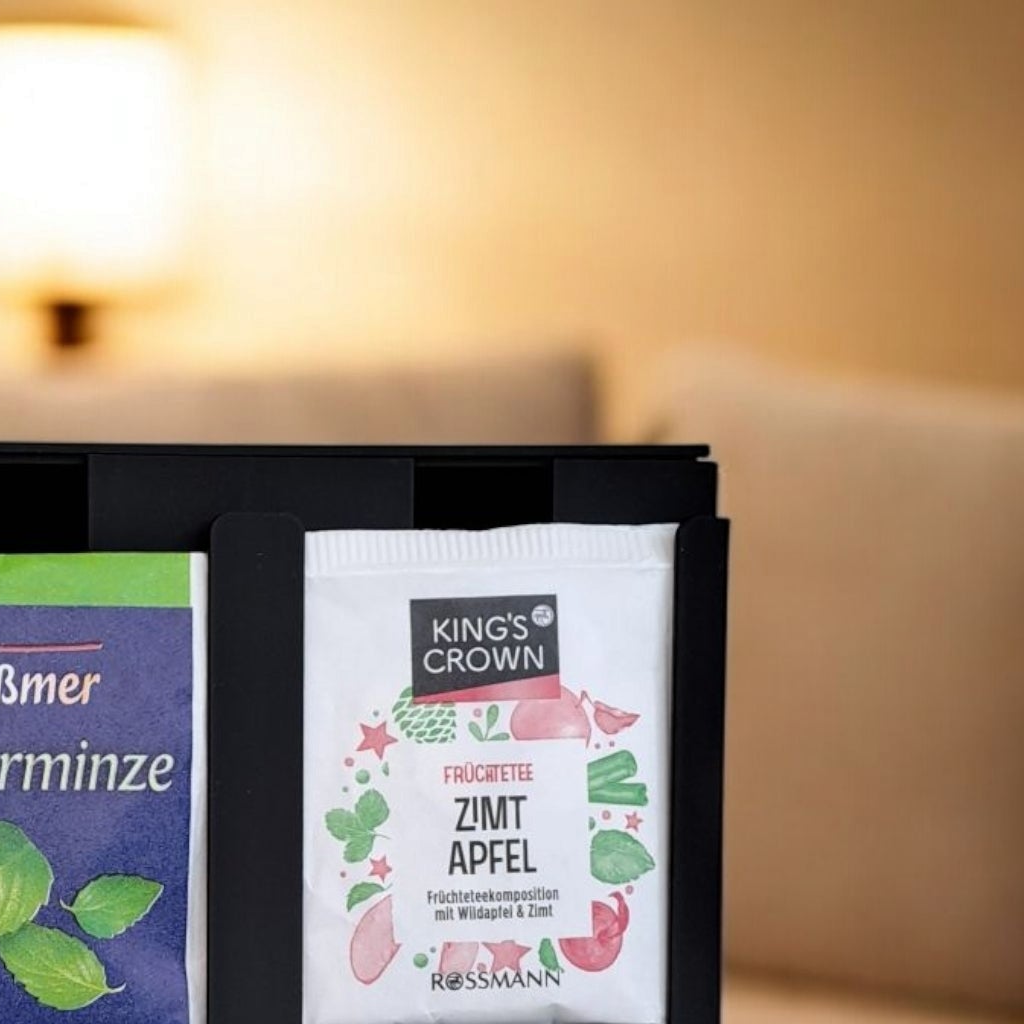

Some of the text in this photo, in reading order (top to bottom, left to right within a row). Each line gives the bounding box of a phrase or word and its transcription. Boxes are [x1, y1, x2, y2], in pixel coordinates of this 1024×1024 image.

[432, 612, 529, 644] KING'S
[423, 645, 545, 674] CROWN
[443, 762, 534, 784] FRÜCHTETEE
[454, 795, 528, 832] ZIMT
[448, 838, 538, 876] APFEL
[426, 886, 560, 905] Früchteteekomposition
[434, 903, 554, 921] mit Wildapfel & Zimt
[431, 968, 561, 992] ROSSMANN
